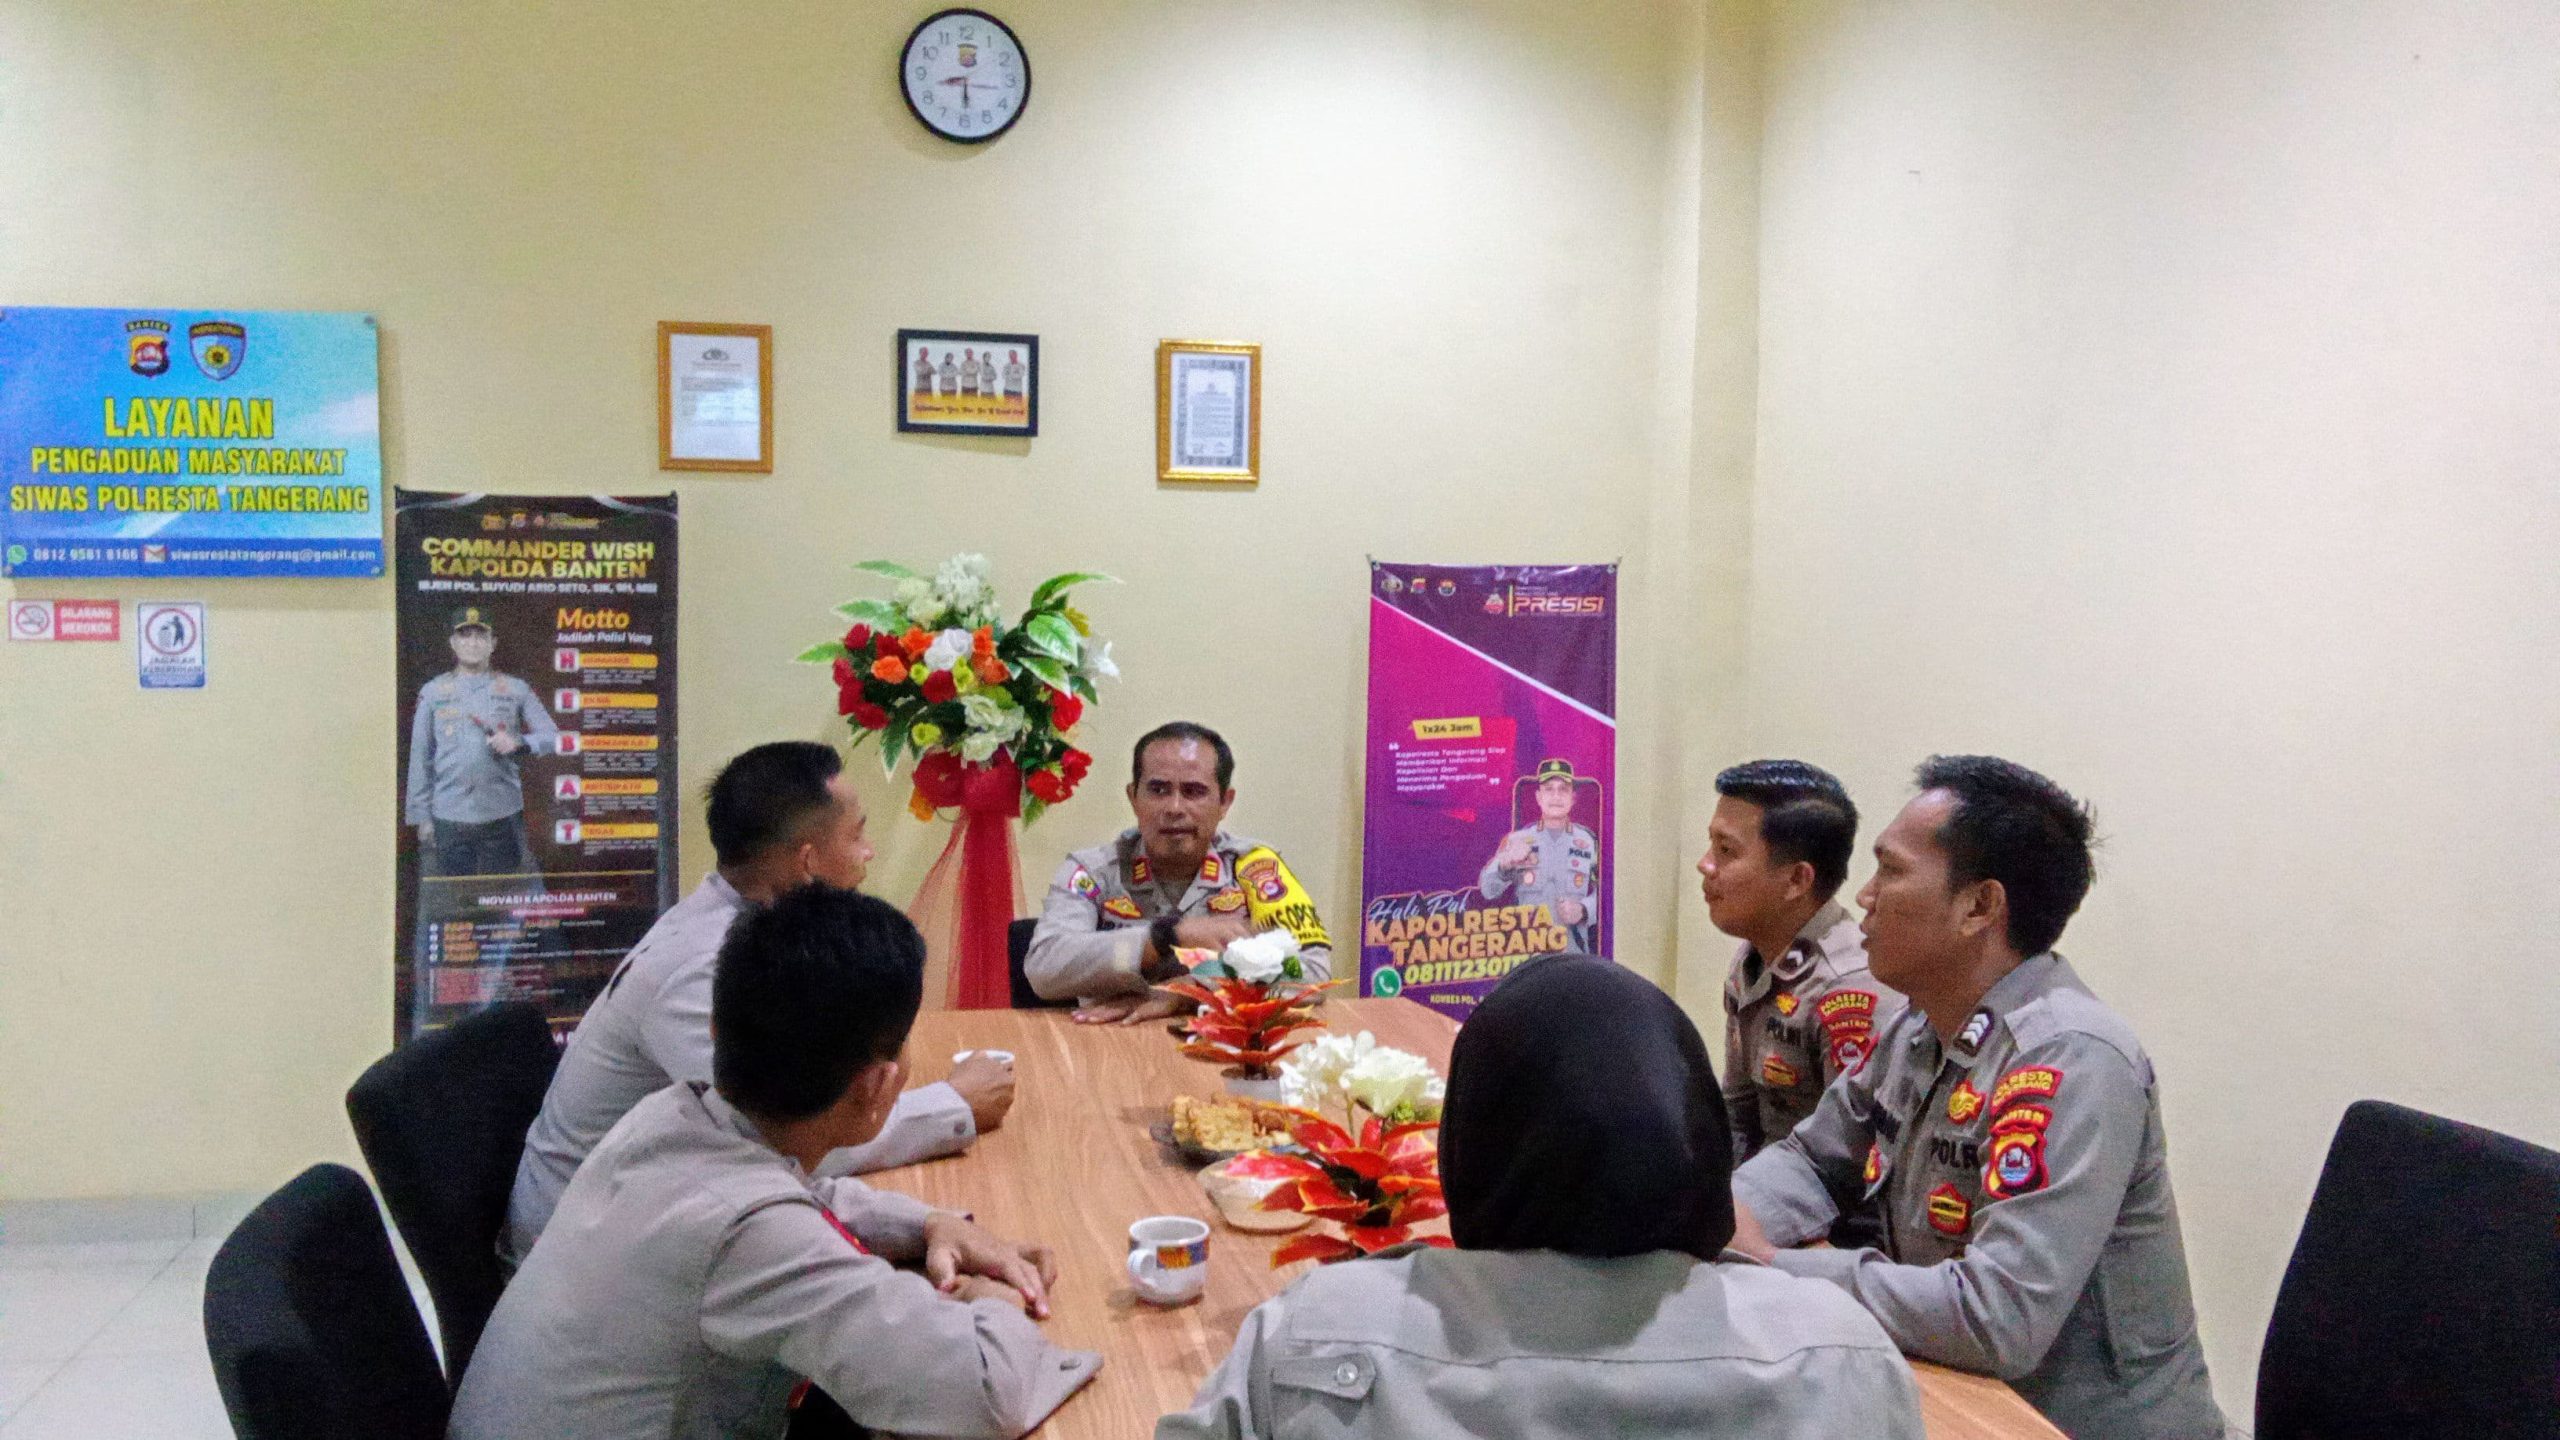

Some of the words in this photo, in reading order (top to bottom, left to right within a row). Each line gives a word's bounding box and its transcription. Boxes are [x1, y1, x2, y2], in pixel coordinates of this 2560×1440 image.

[939, 31, 950, 46] 11
[958, 25, 976, 41] 12
[998, 52, 1011, 67] 2
[915, 66, 927, 80] 9
[922, 90, 934, 105] 8
[938, 105, 947, 117] 7
[105, 397, 275, 439] LAYANAN
[31, 448, 180, 474] PENGADUAN
[188, 449, 347, 475] MASYARAKAT
[10, 486, 88, 511] SIWAS
[98, 486, 220, 511] POLRESTA
[228, 487, 370, 512] TANGERANG
[33, 548, 66, 561] 0812
[422, 538, 587, 560] COMMANDER
[592, 542, 655, 560] WISH
[431, 557, 547, 578] KAPOLDA
[552, 561, 647, 579] BANTEN
[1515, 597, 1604, 612] PRESISI
[557, 608, 630, 630] Motto
[556, 632, 595, 643] Jadilah
[596, 632, 626, 643] Polisi
[627, 633, 653, 646] Yang
[560, 652, 575, 669] H
[1423, 724, 1447, 734] 1x24
[1450, 723, 1474, 733] Jam
[561, 779, 576, 795] A
[562, 823, 575, 841] T
[479, 895, 524, 906] INOVASI
[525, 892, 574, 904] KAPOLDA
[577, 891, 618, 902] BANTEN
[1366, 904, 1552, 944] KAPOLRESTA
[1390, 926, 1568, 967] TANGERANG
